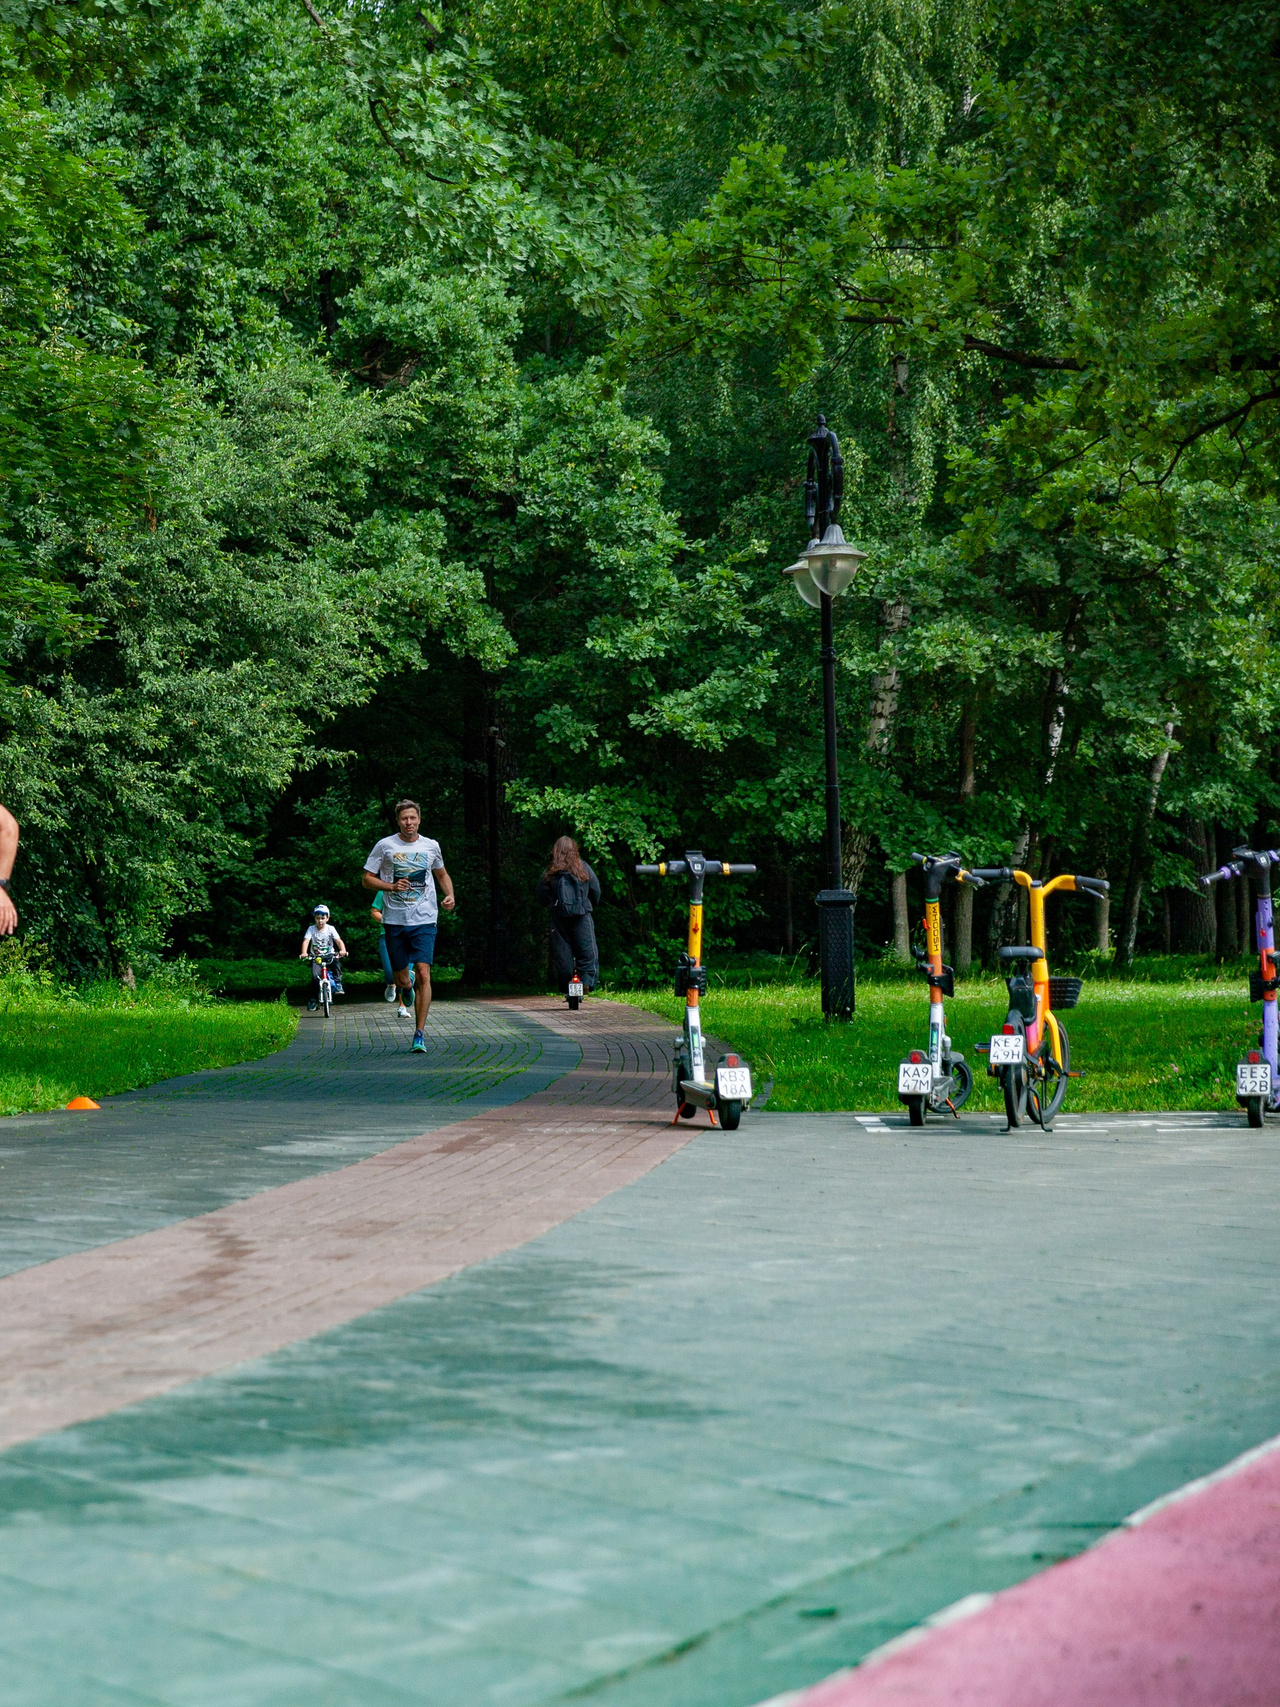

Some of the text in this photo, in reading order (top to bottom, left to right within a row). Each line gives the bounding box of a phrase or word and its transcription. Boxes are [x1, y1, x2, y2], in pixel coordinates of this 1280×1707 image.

[720, 1070, 745, 1082] KB3
[903, 1068, 929, 1078] KA9
[1240, 1067, 1268, 1079] EE3
[722, 1084, 747, 1096] 18A
[902, 1079, 929, 1091] 47M
[1239, 1080, 1268, 1092] 42B
